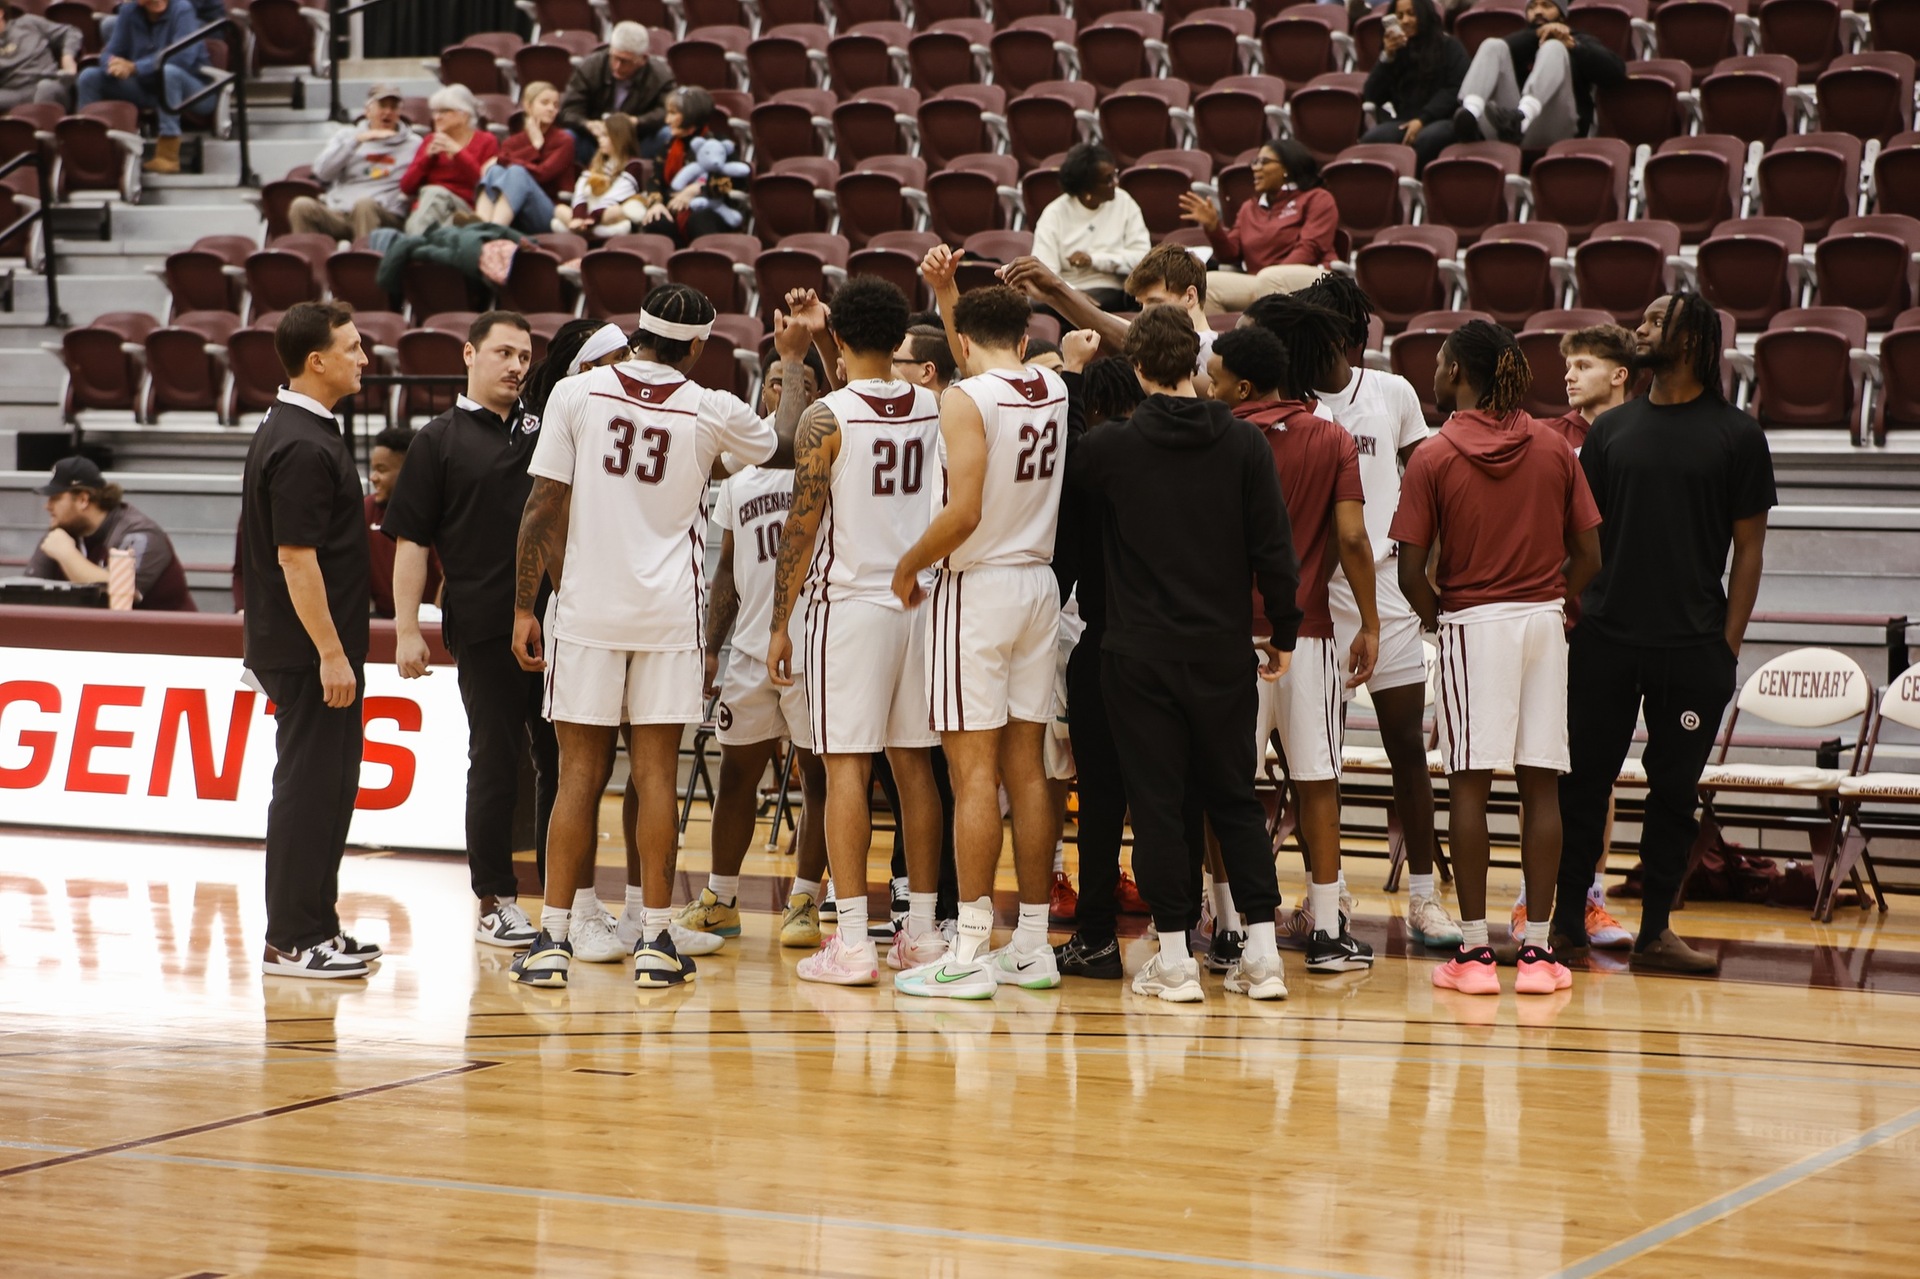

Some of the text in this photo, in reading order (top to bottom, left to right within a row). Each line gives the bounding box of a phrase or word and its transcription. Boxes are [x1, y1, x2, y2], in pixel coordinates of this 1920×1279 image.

[603, 415, 672, 486] 33
[872, 437, 924, 497] 20
[1014, 420, 1058, 483] 22
[738, 491, 793, 528] CENTENAR
[755, 519, 784, 564] 10
[1758, 669, 1854, 698] CENTENARY
[0, 680, 422, 811] GENS
